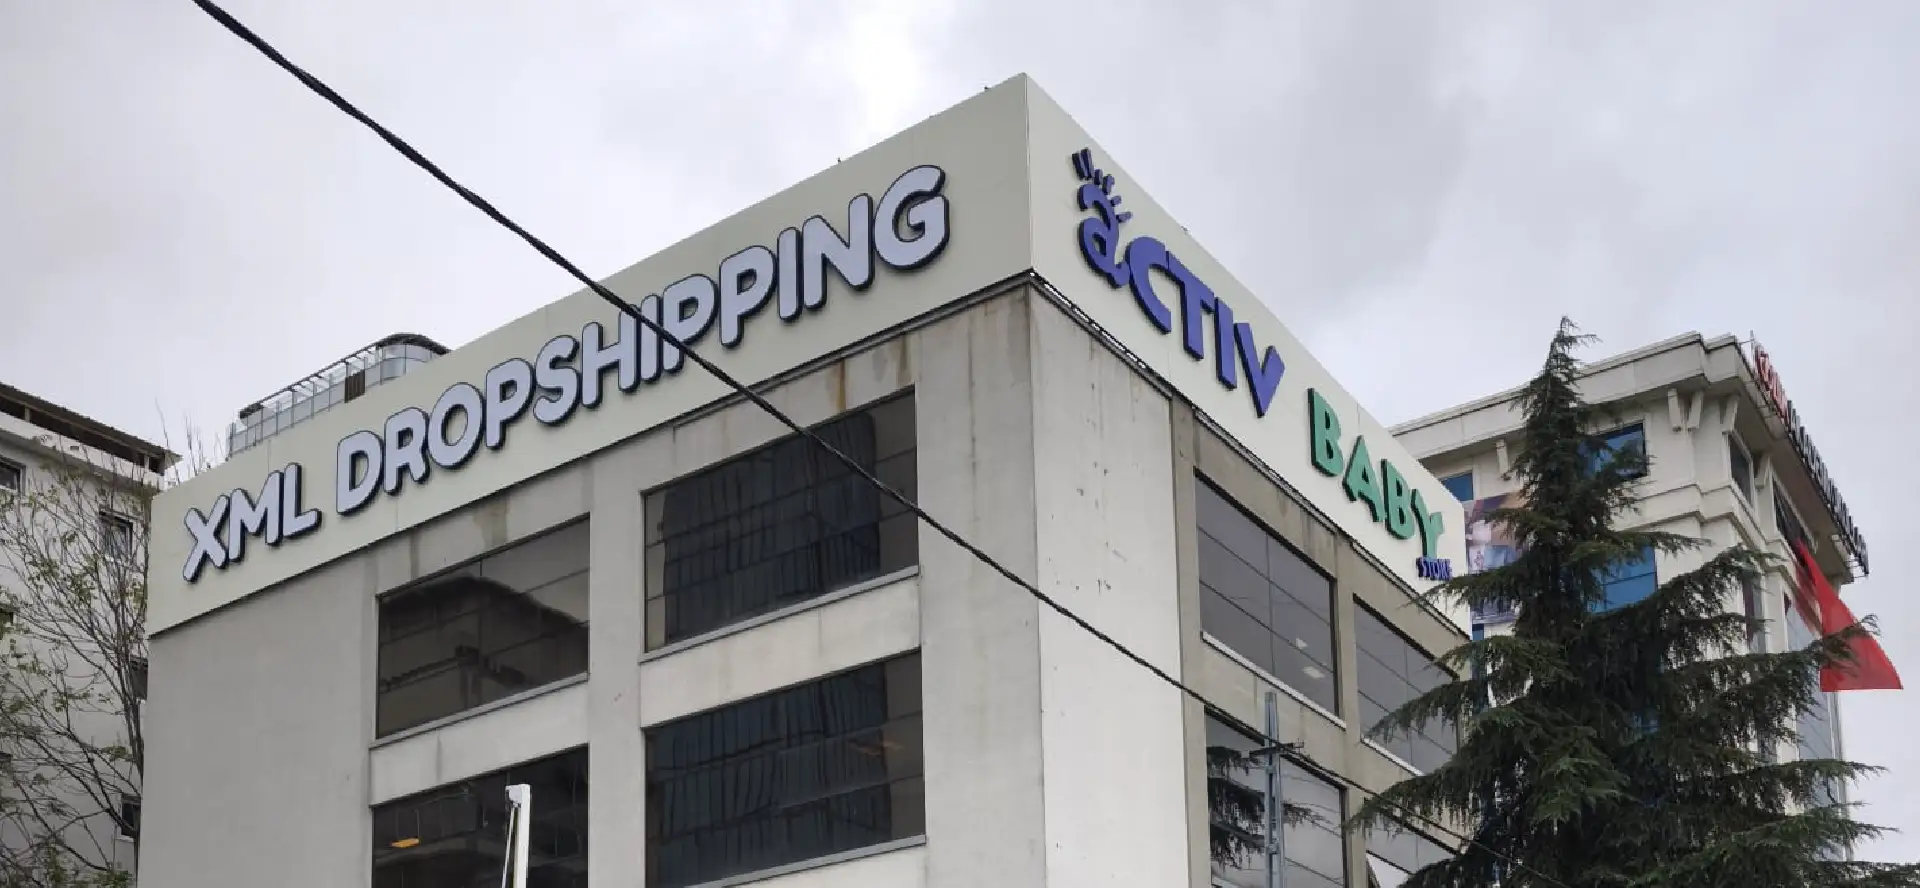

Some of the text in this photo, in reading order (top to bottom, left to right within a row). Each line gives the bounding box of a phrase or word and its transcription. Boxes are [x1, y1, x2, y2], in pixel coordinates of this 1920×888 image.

[183, 164, 949, 581] XML DROPSHIPPING
[1307, 388, 1444, 558] BABY
